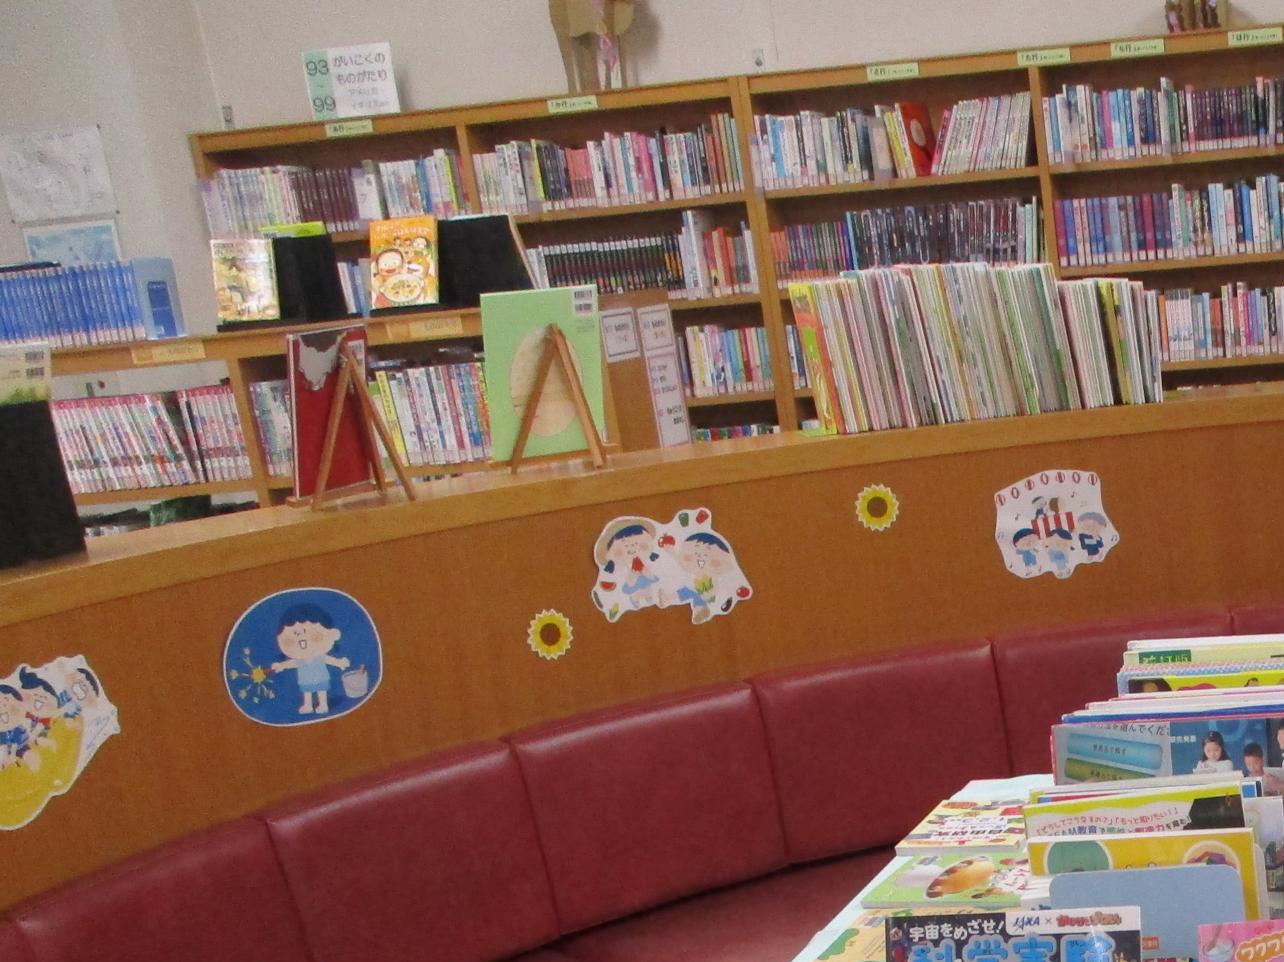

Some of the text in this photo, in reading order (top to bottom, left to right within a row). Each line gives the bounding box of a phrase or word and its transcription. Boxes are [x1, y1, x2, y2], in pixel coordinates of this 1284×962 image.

[305, 59, 330, 76] 93
[334, 52, 386, 67] がいこくの
[336, 69, 388, 85] ものがたり
[312, 95, 337, 112] 99
[909, 918, 1005, 942] 宇宙をめざせ!
